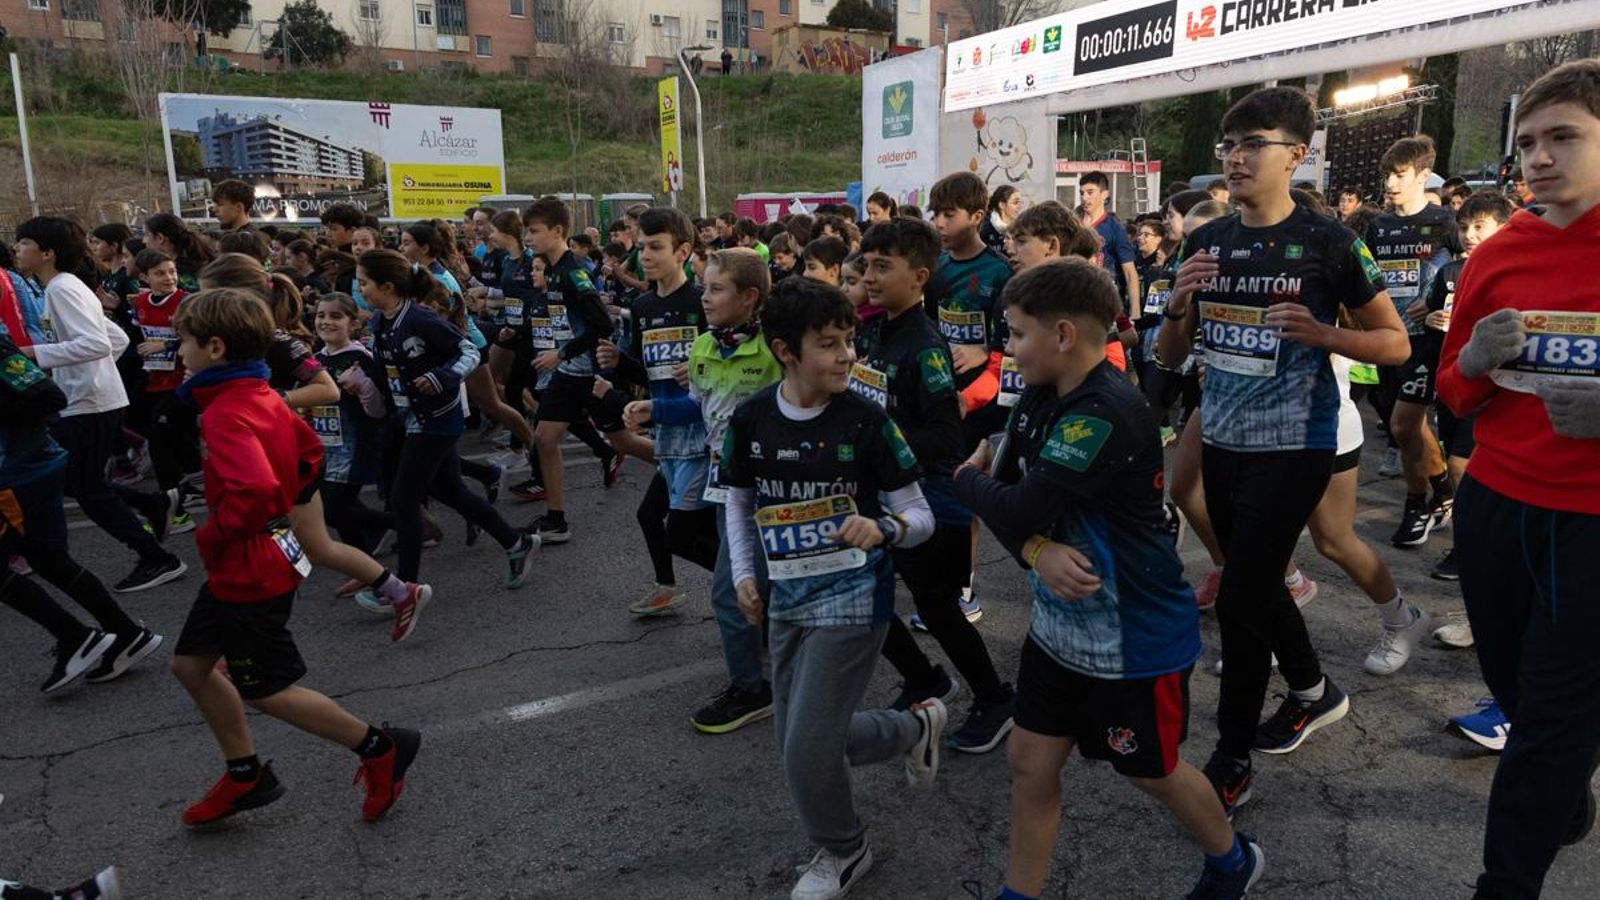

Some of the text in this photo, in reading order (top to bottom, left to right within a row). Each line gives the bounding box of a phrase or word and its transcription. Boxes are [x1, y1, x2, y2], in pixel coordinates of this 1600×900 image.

[1186, 5, 1217, 41] 42
[1080, 15, 1173, 62] 00:00:11.666
[419, 128, 478, 148] Alcázar
[876, 148, 918, 164] calderón
[463, 181, 492, 189] OSUNA
[279, 197, 368, 212] PROMON
[1376, 242, 1432, 256] SAN ANTÓN
[1235, 273, 1302, 295] ANTÓN
[940, 321, 984, 339] 10215
[1203, 320, 1277, 351] 10369
[1521, 335, 1600, 366] 183
[776, 449, 800, 460] jaén
[790, 477, 858, 500] ANTÓN
[763, 520, 838, 552] 1159
